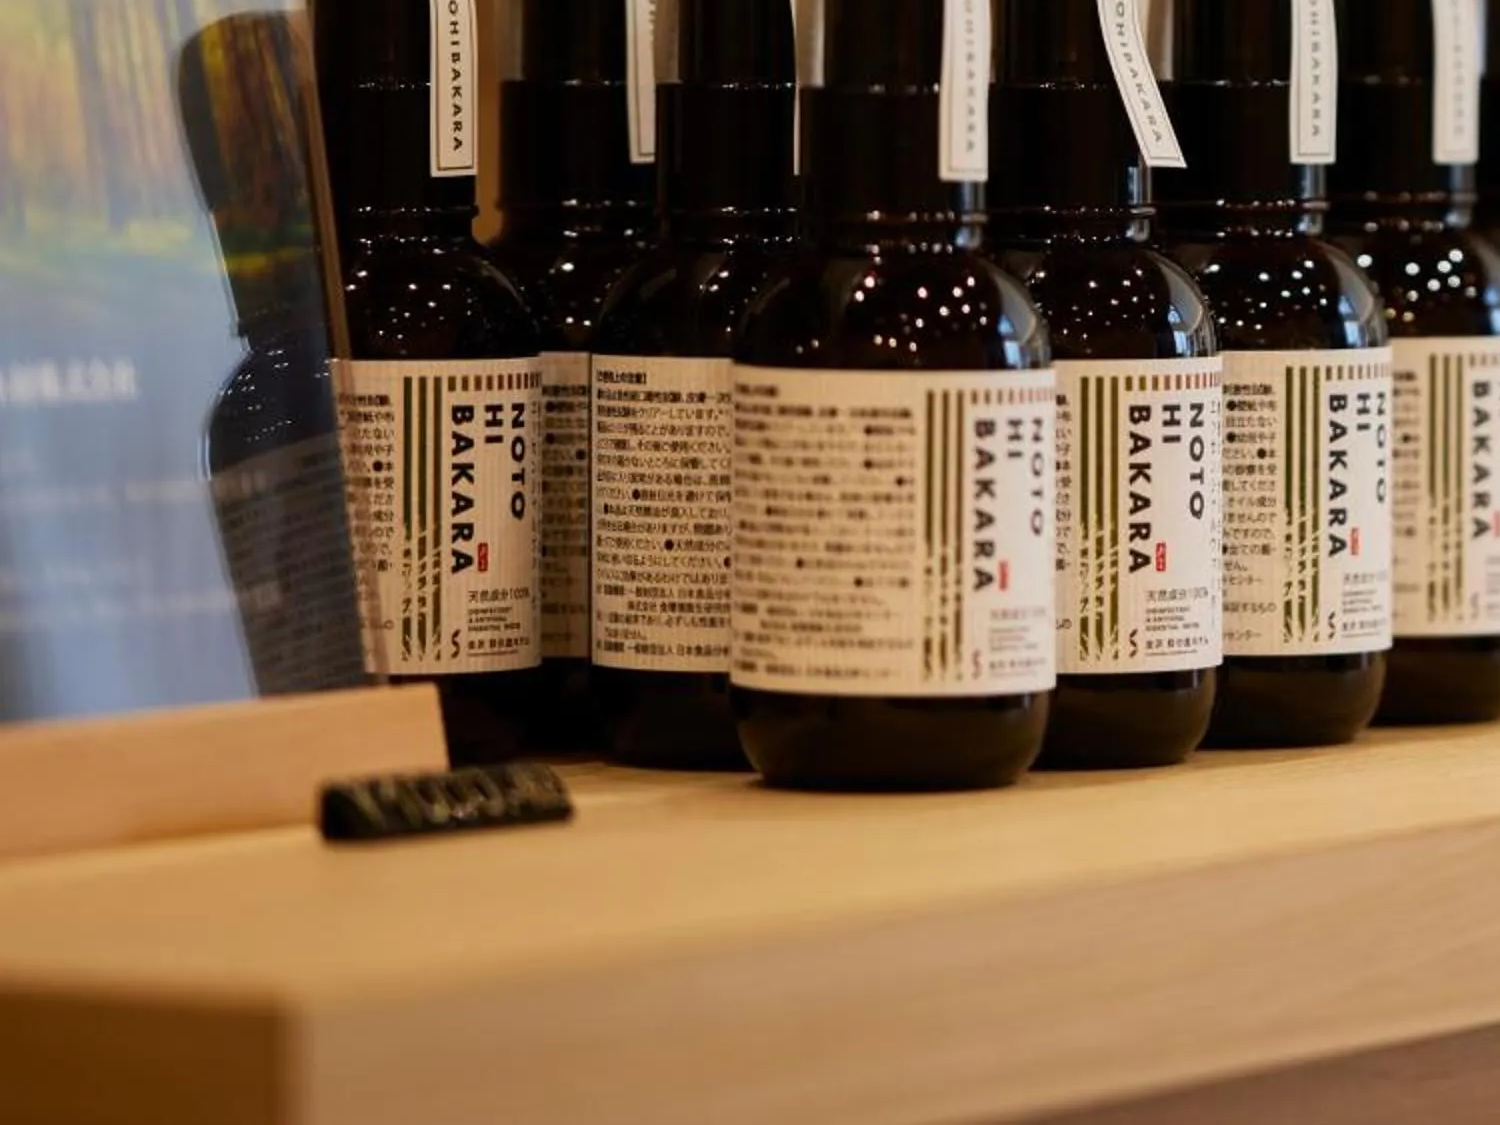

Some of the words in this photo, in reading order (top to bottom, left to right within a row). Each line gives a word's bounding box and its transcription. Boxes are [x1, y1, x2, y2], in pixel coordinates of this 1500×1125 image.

[484, 404, 504, 444] HI
[510, 402, 527, 522] NOTO
[1007, 418, 1025, 459] HI
[1161, 403, 1182, 444] HI
[1188, 402, 1205, 521] NOTO
[1356, 392, 1371, 432] HI
[1375, 391, 1387, 504] NOTO
[450, 404, 475, 575] BAKARA
[972, 418, 998, 592] BAKARA
[1030, 418, 1046, 537] NOTO
[1128, 404, 1152, 574] BAKARA
[1328, 393, 1348, 558] BAKARA
